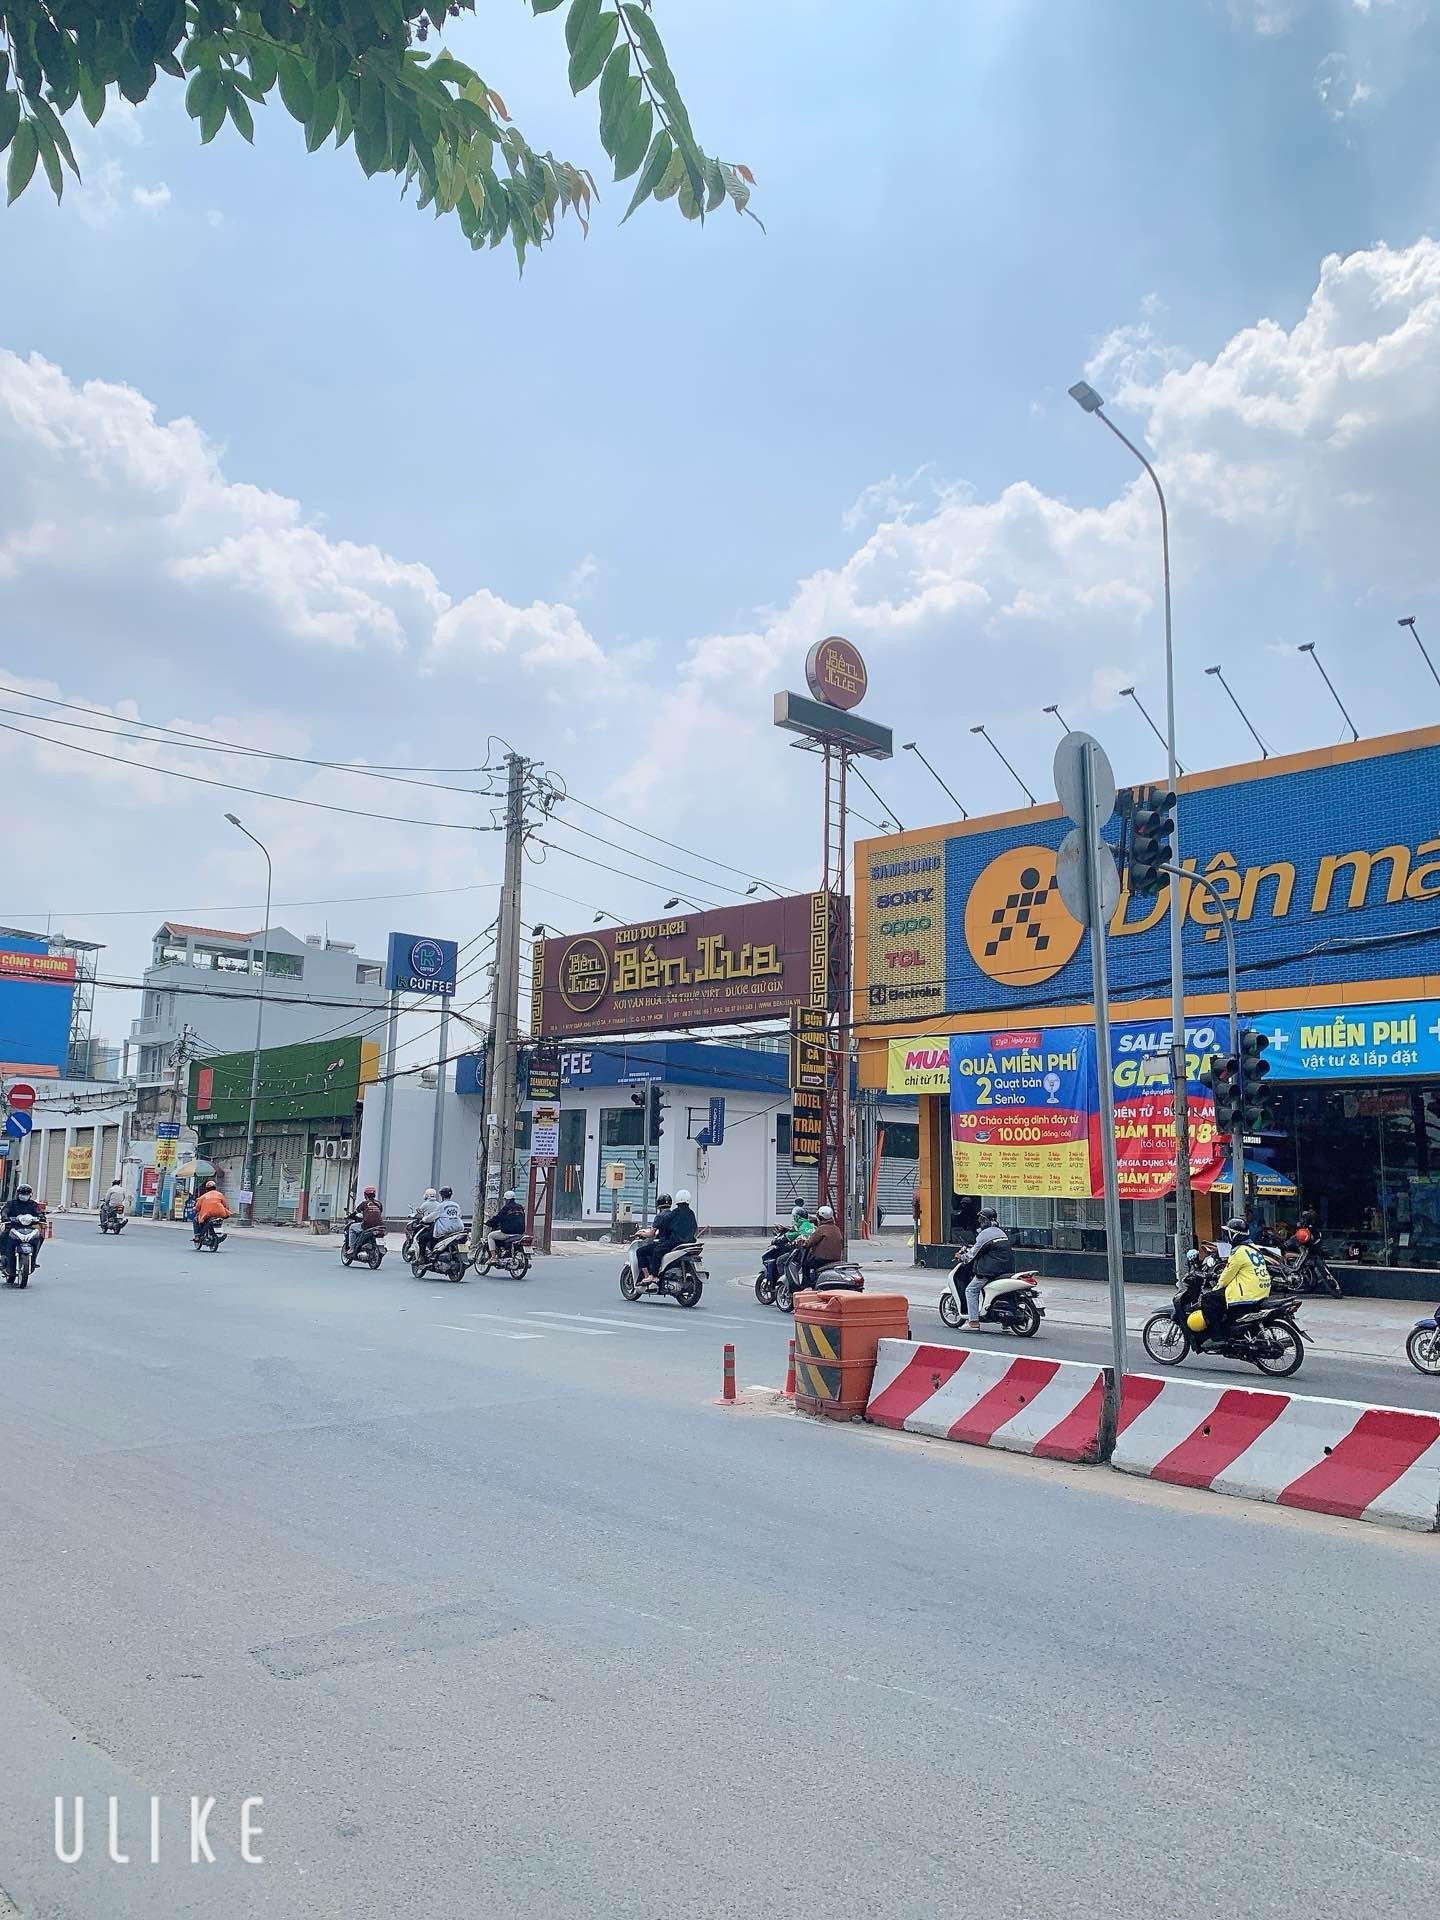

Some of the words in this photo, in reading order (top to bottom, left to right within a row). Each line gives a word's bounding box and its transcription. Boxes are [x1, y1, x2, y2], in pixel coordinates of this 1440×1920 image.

[876, 887, 934, 909] SONY
[615, 930, 640, 943] KHU
[640, 925, 659, 940] DU
[659, 920, 687, 941] LỊCH
[2, 954, 31, 967] CÔNG
[32, 958, 68, 971] CHỨNG
[885, 950, 925, 969] TCL
[613, 943, 692, 993] Bến
[409, 977, 453, 993] COFFEE
[888, 985, 942, 1001] Electrolux
[803, 1012, 823, 1027] BÚN
[1300, 1015, 1366, 1050] MIỄN
[1373, 1013, 1417, 1046] PHÍ
[1118, 1033, 1174, 1052] SALE
[560, 1052, 593, 1075] FEE
[959, 1053, 998, 1077] QUÀ
[1001, 1048, 1043, 1074] MIỄN
[1047, 1050, 1077, 1072] PHÍ
[1302, 1054, 1325, 1072] vật
[1328, 1054, 1345, 1067] tư
[1350, 1053, 1361, 1066] &
[1364, 1051, 1388, 1069] lắp
[1391, 1049, 1419, 1067] đặt
[976, 1077, 993, 1105] 2
[994, 1078, 1021, 1091] Quạt
[1022, 1077, 1042, 1089] bàn
[994, 1093, 1026, 1105] Senko
[794, 1092, 822, 1108] HOTEL
[1139, 1104, 1154, 1117] TỬ
[959, 1114, 977, 1128] 30
[1003, 1115, 1030, 1127] chống
[1031, 1115, 1050, 1125] dính
[1050, 1115, 1068, 1127] đáy
[998, 1127, 1041, 1141] 10.000
[794, 1138, 821, 1154] LONG
[1128, 1159, 1140, 1167] GIA
[1142, 1159, 1164, 1167] DỤNG
[1117, 1168, 1149, 1184] GIẢM
